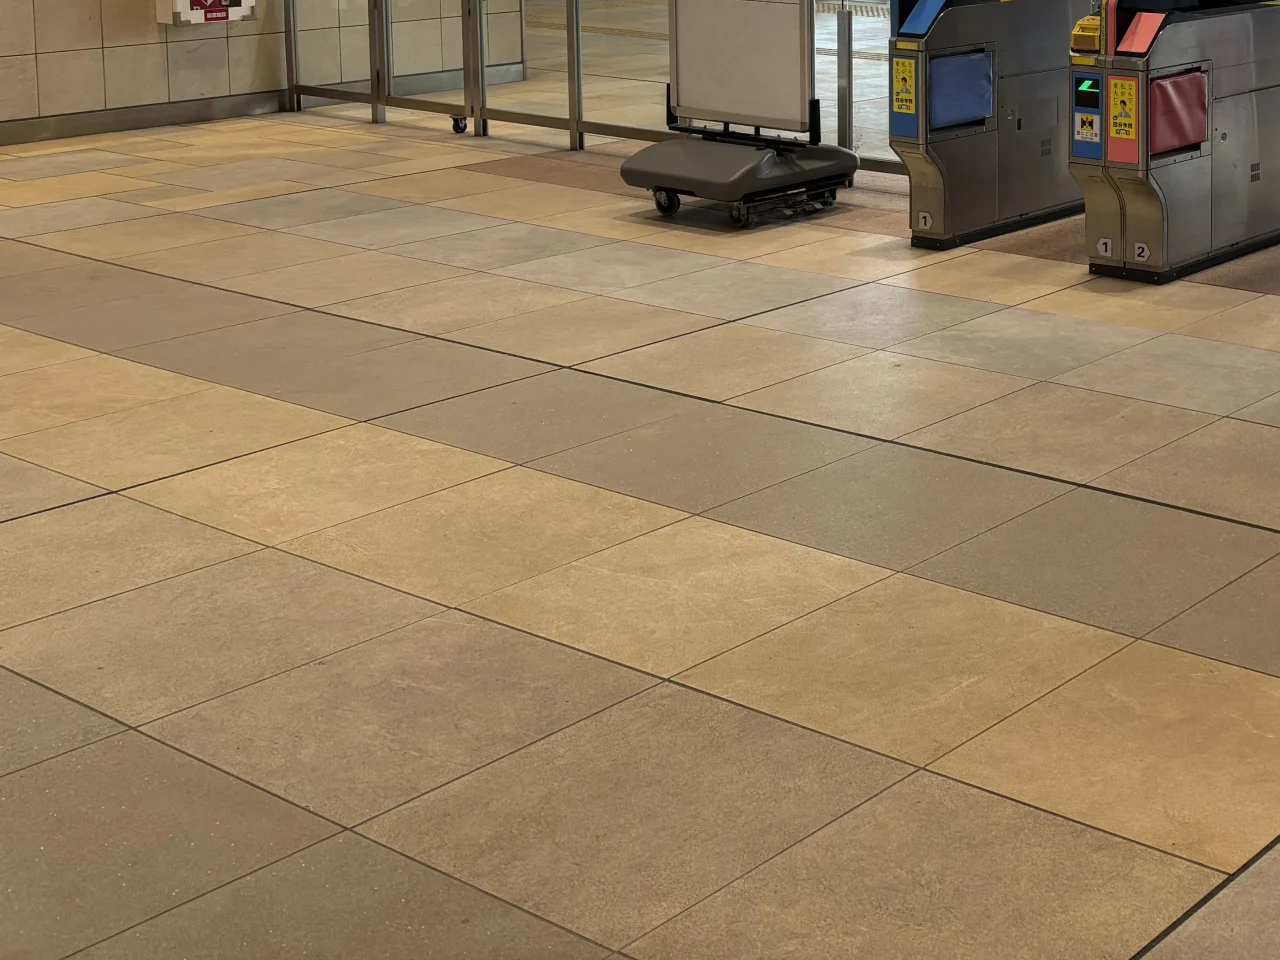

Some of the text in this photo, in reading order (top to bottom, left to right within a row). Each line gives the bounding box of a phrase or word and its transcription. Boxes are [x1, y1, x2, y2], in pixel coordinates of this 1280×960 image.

[1113, 121, 1133, 129] 四谷学院
[921, 216, 928, 227] 1
[1102, 241, 1108, 253] 1
[1136, 246, 1145, 258] 2
